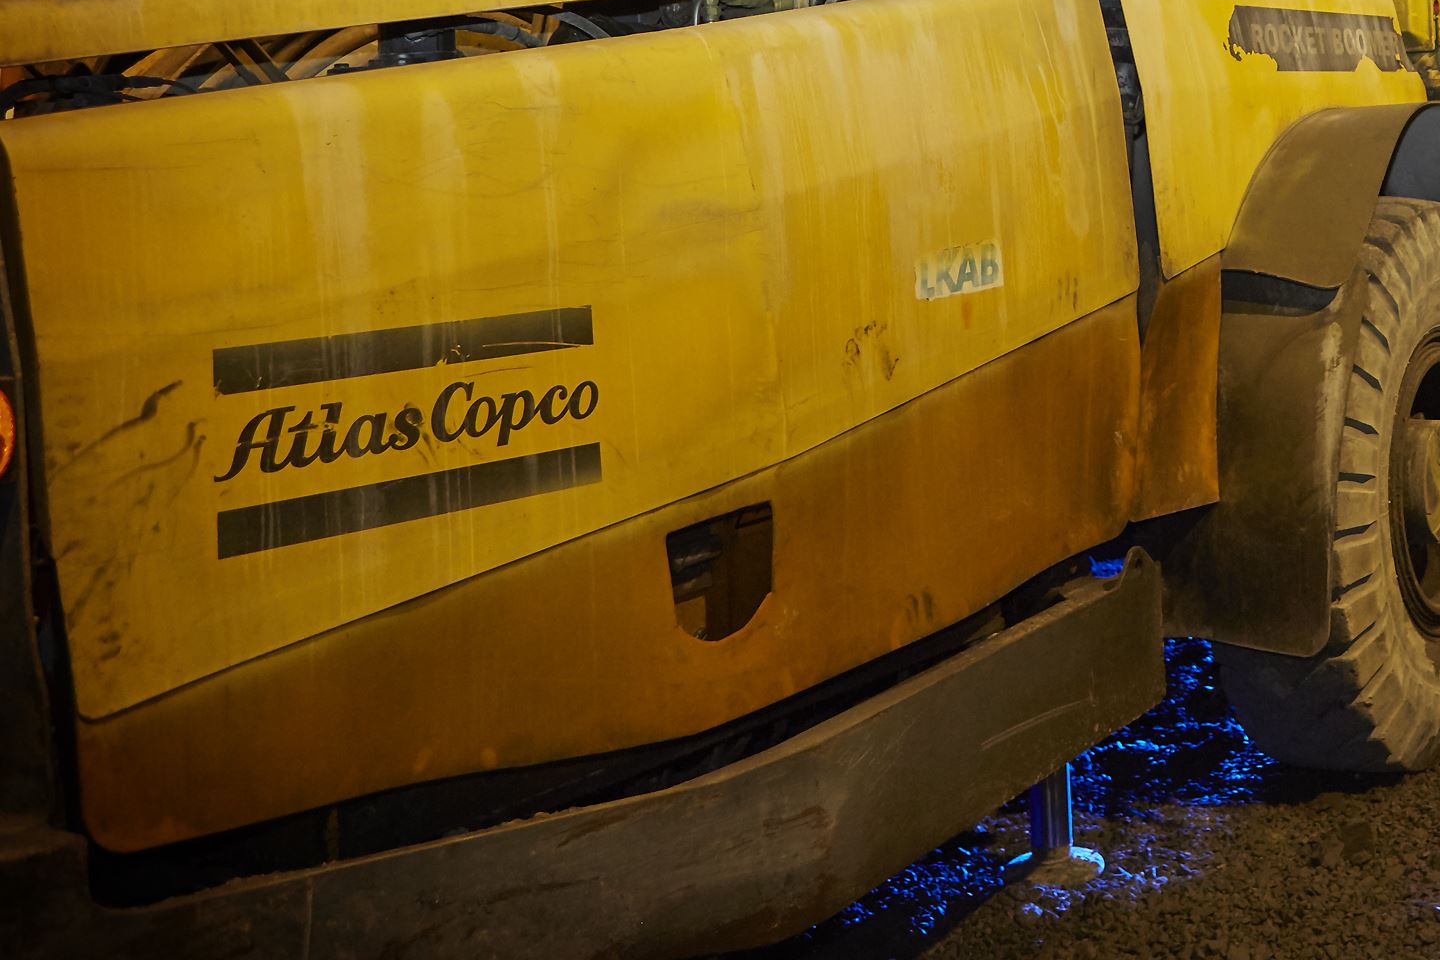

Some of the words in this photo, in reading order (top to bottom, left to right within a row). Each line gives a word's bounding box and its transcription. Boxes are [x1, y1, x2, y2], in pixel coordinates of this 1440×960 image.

[1250, 23, 1326, 55] ROCKET
[919, 243, 999, 297] LKAB
[213, 401, 425, 482] Atlas
[430, 380, 599, 447] Copco
